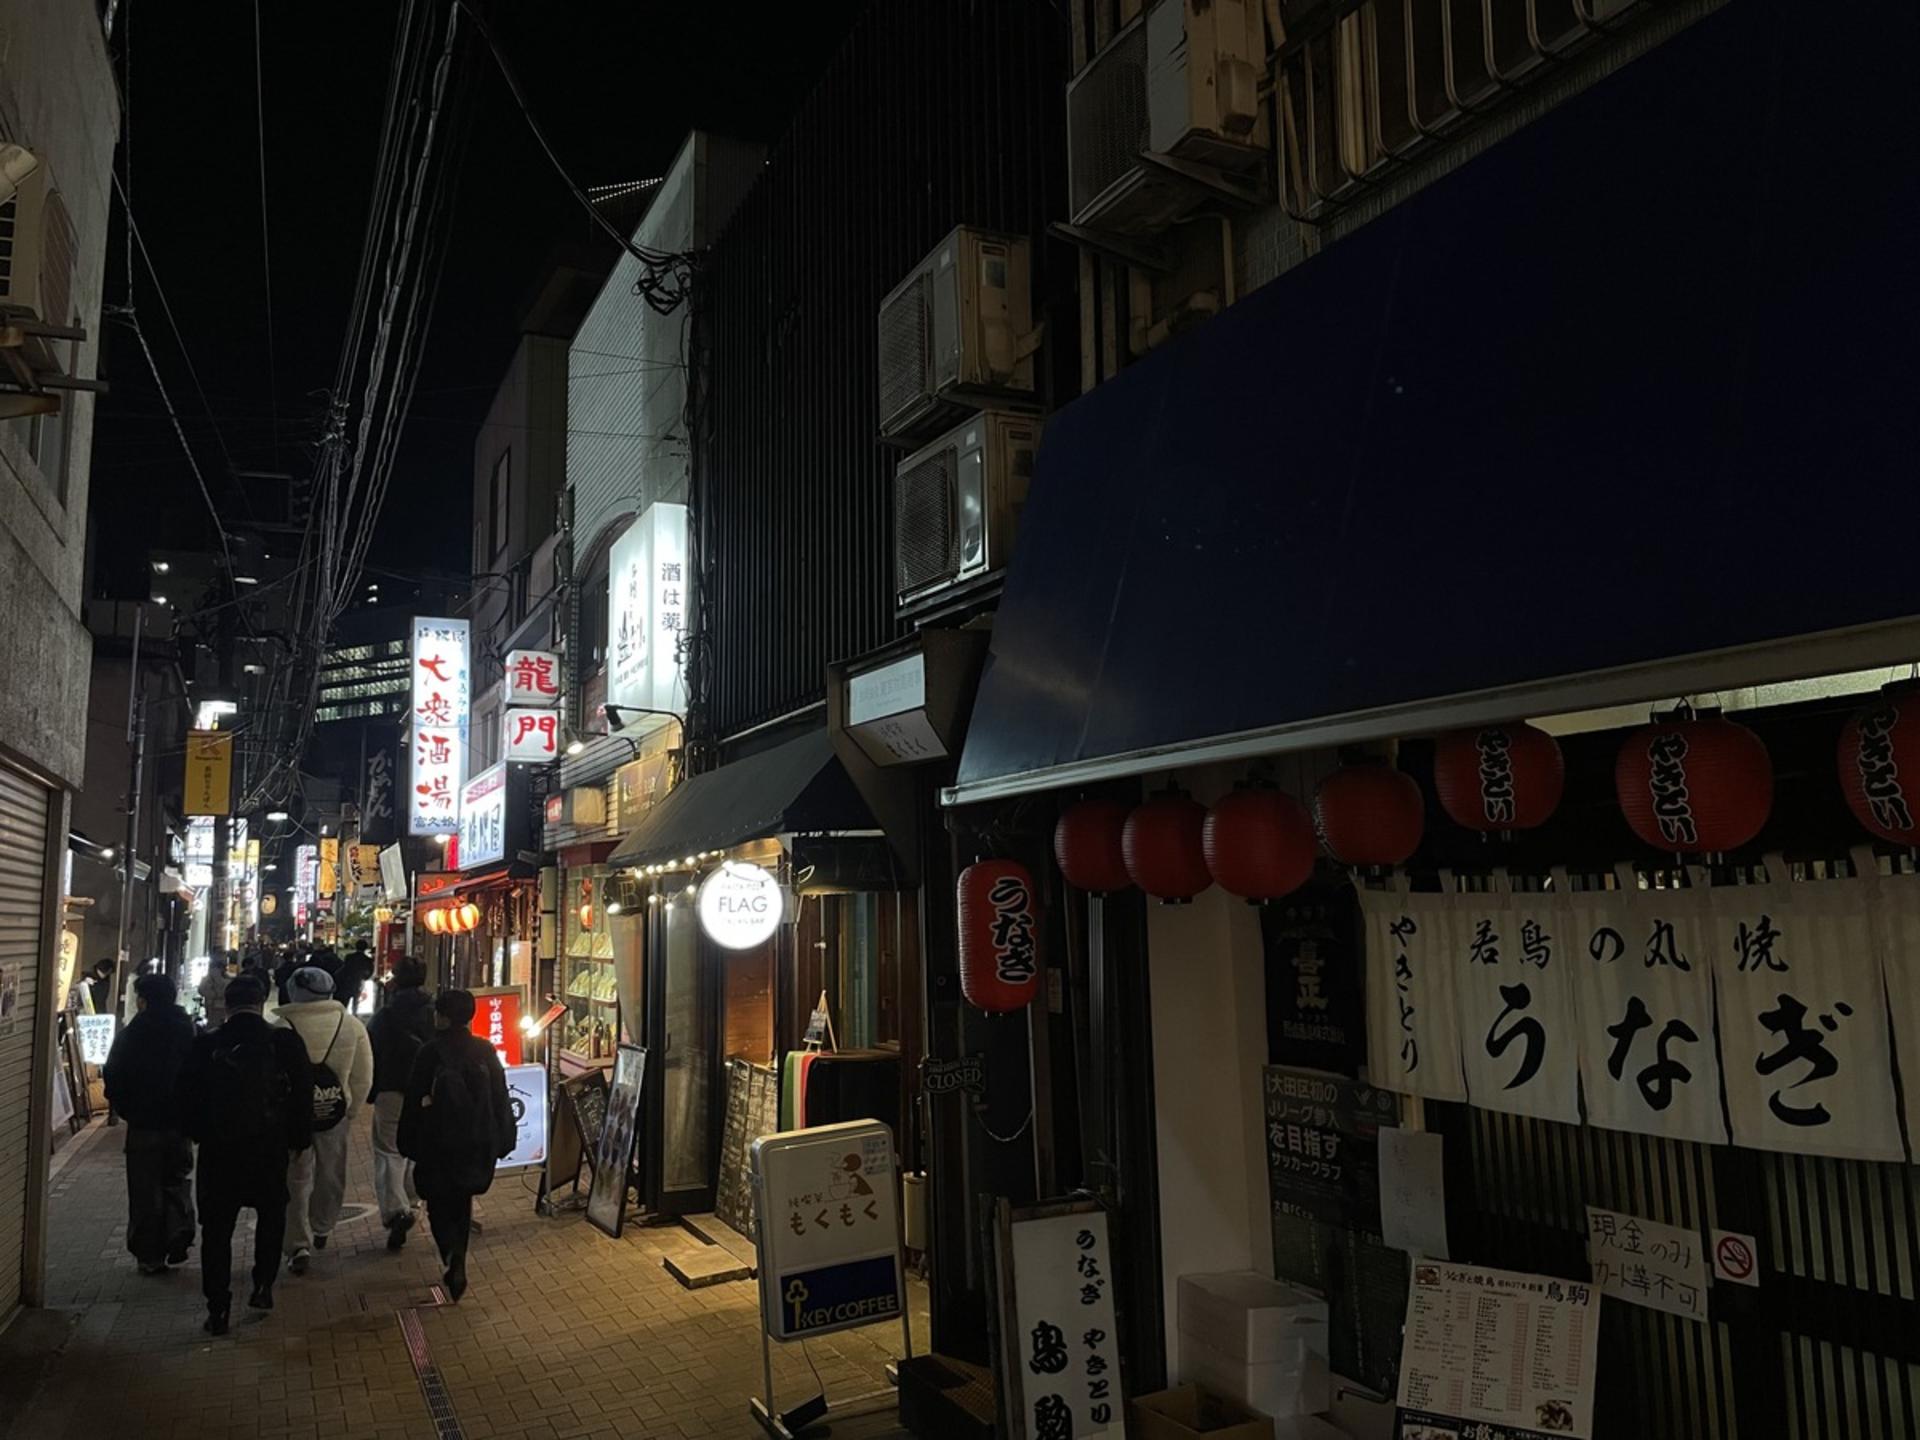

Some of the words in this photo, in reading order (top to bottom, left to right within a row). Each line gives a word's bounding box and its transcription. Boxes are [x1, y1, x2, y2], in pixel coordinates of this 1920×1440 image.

[661, 562, 681, 631] 酒は薬
[416, 654, 453, 809] 大衆酒場
[513, 656, 558, 752] 龍門
[1648, 733, 1698, 845] やきとり
[719, 895, 767, 912] FLAG
[988, 876, 1035, 985] うなぎ
[1470, 914, 1789, 970] 若鳥の丸焼
[1390, 916, 1418, 1073] やきとり
[927, 1068, 982, 1089] CLOSED
[1486, 983, 1853, 1126] うなぎ
[1268, 1121, 1342, 1160] を目指す
[790, 1200, 879, 1236] もくもく
[1591, 1214, 1691, 1269] 現金のみ
[1076, 1229, 1105, 1305] うなぎ
[1545, 1281, 1590, 1306] 鳥駒
[1594, 1262, 1701, 1313] カード等不可
[801, 1309, 834, 1328] KEY
[835, 1294, 897, 1321] COFFEE
[1083, 1328, 1111, 1424] やきとり
